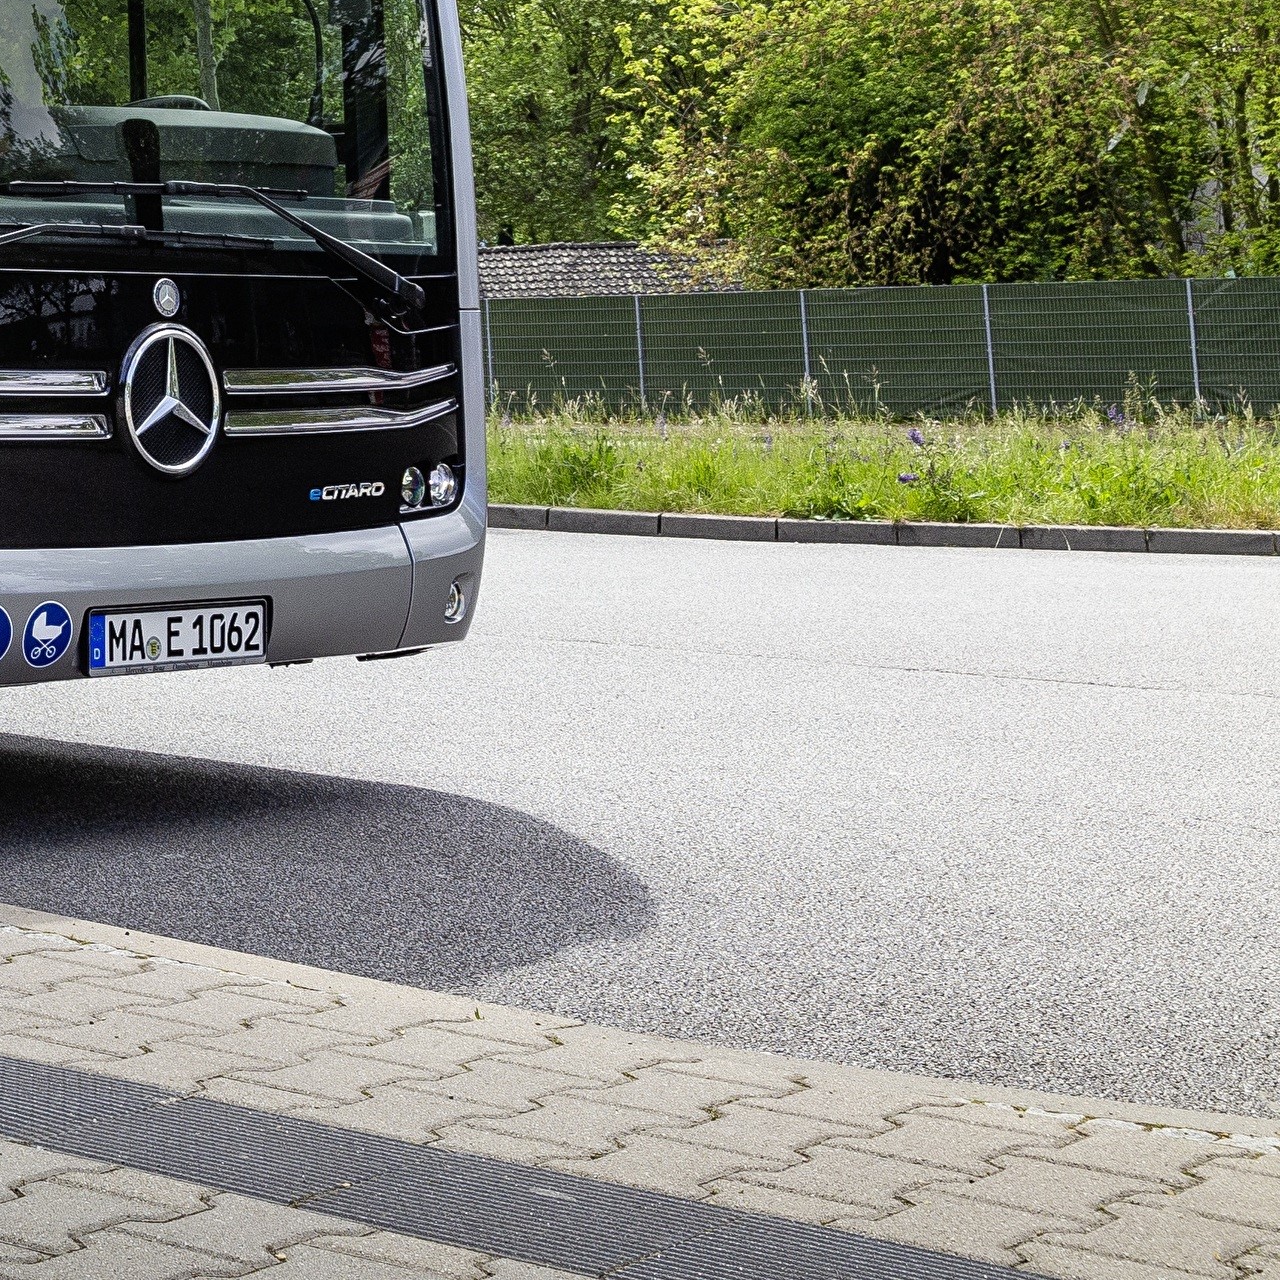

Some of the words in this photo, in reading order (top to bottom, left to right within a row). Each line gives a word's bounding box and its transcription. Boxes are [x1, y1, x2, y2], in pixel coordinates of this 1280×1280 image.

[309, 481, 385, 501] eCITARO
[108, 618, 146, 662] MA
[192, 611, 260, 656] 1062
[93, 648, 101, 660] D
